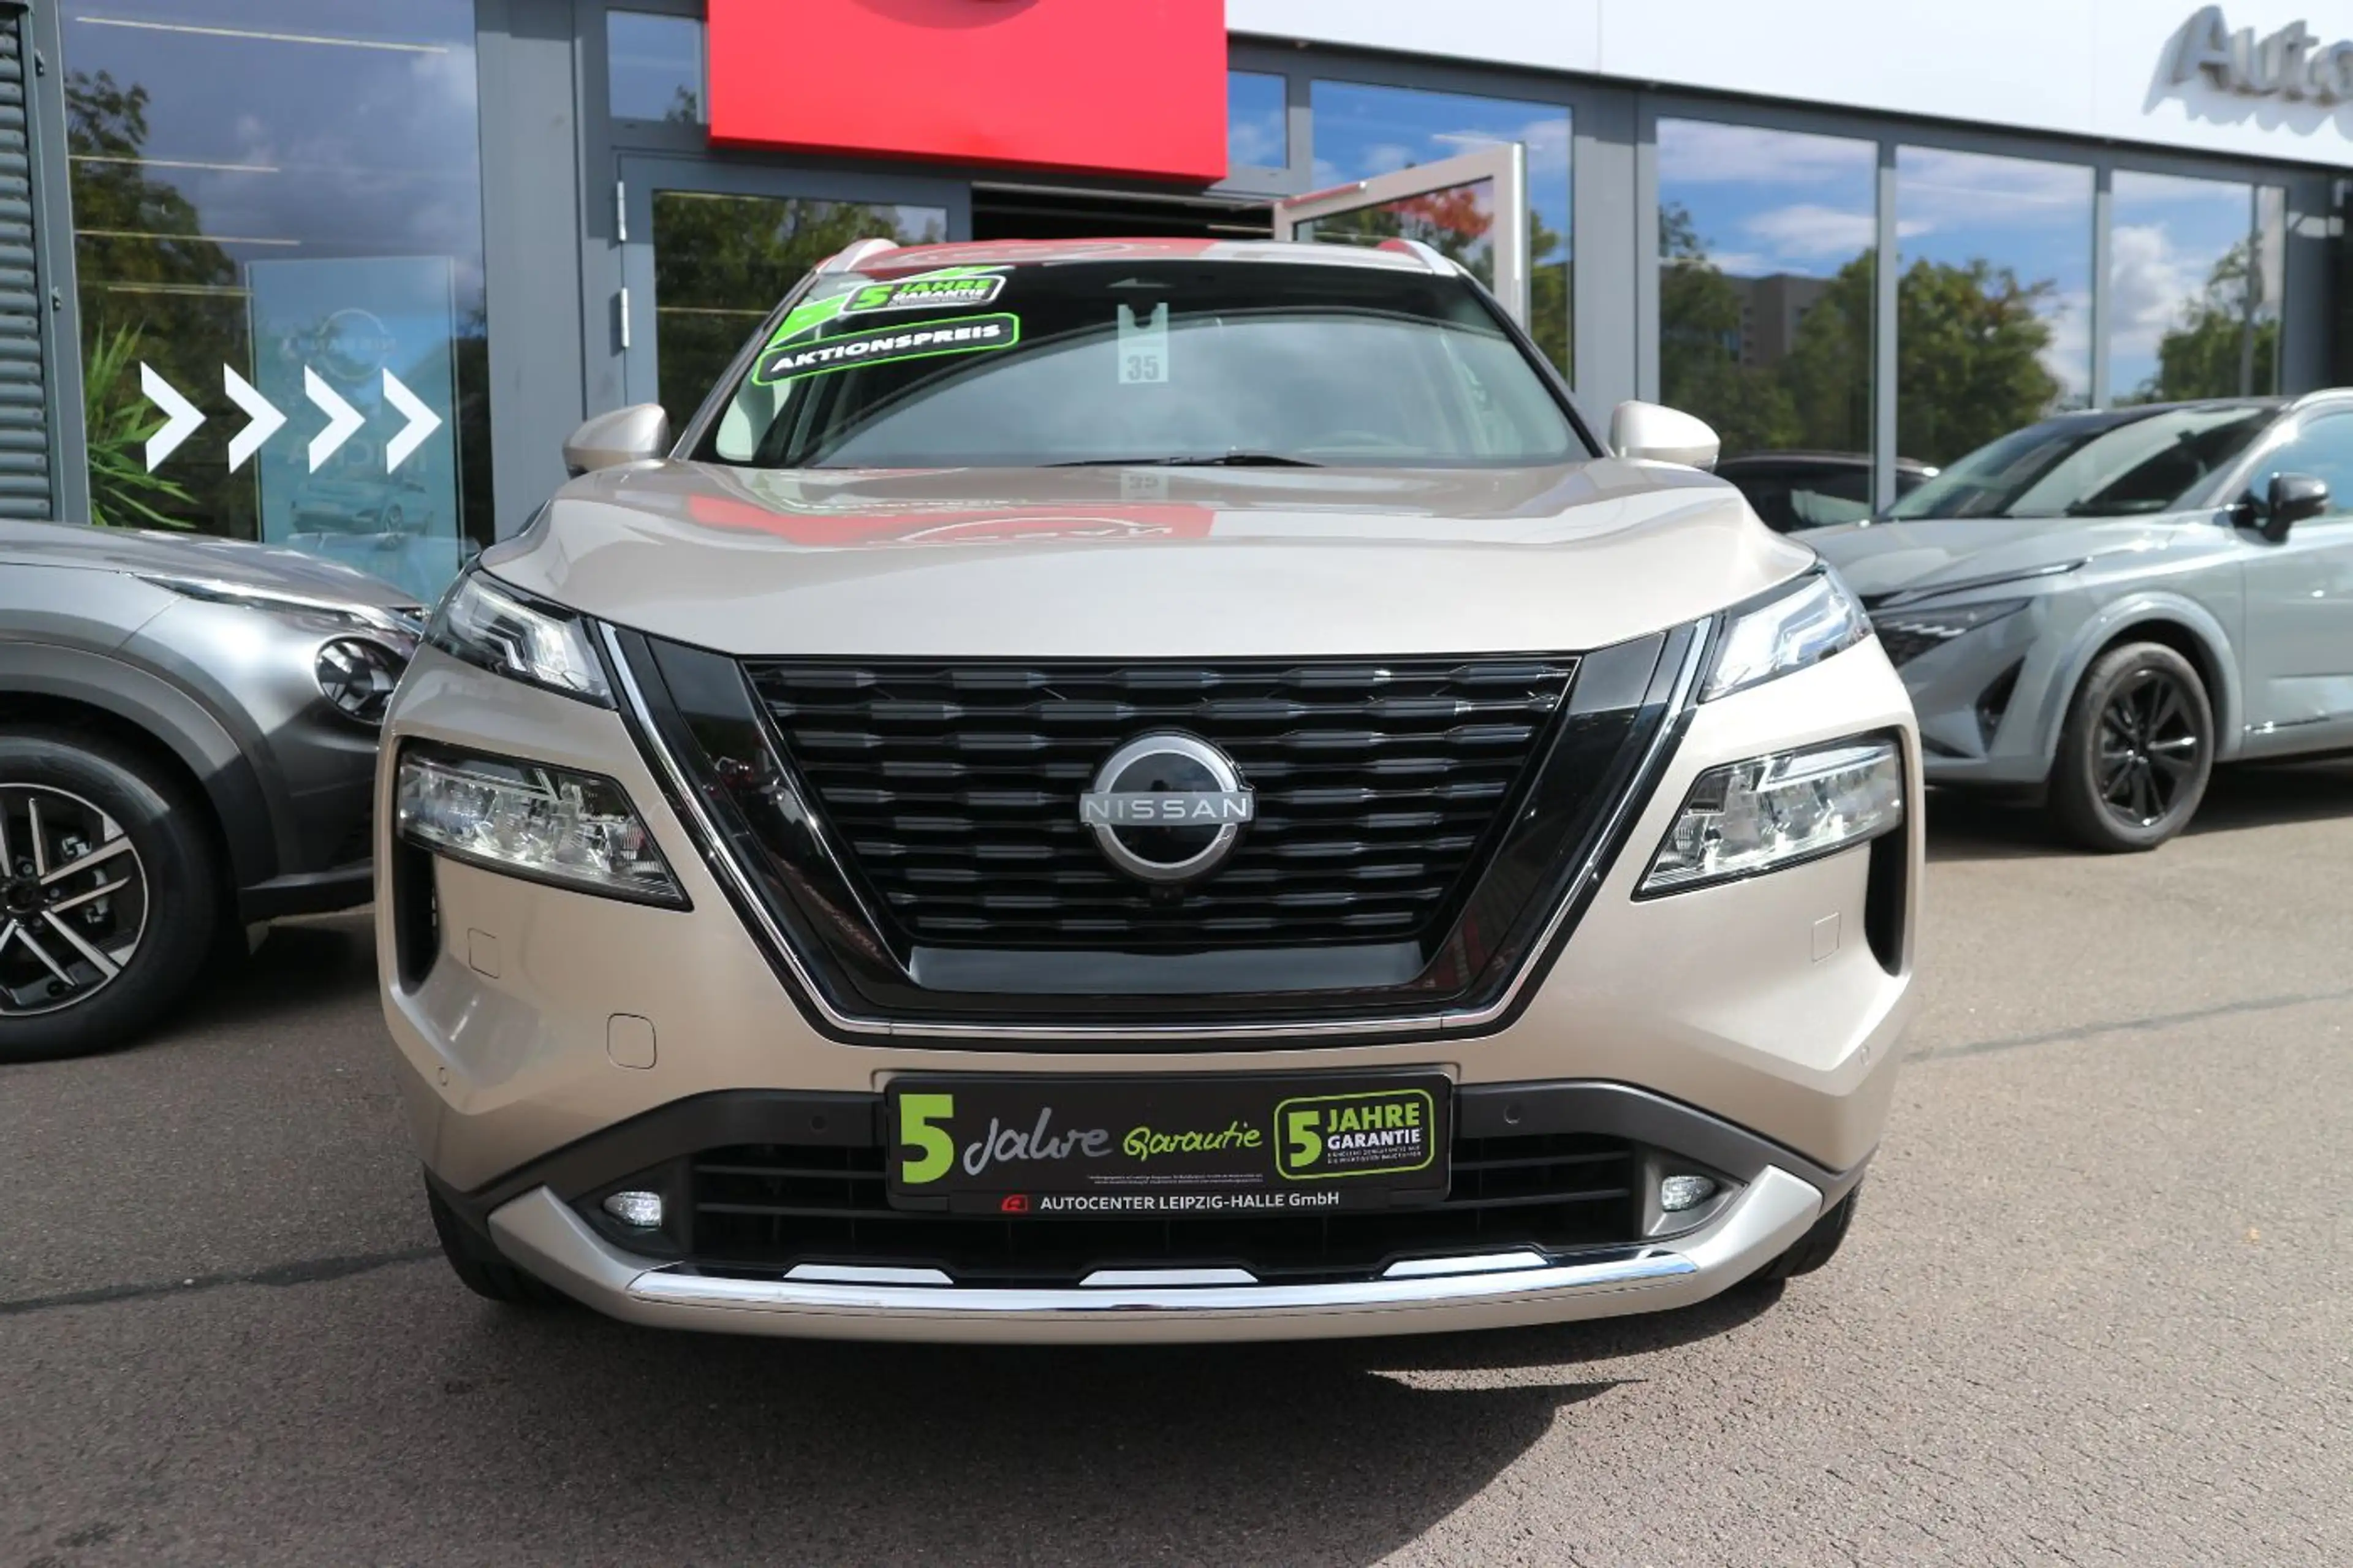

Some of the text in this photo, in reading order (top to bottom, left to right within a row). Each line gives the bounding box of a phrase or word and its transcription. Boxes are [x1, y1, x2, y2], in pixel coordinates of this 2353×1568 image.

[851, 285, 893, 309] 5
[901, 279, 993, 293] JAHRE
[770, 324, 1001, 372] AKTIONSPREIS
[1127, 355, 1160, 381] 35
[1085, 798, 1247, 819] NISSAN
[1327, 1102, 1420, 1133] JAHRE
[899, 1094, 1263, 1184] 5 Jahre Garantie
[1288, 1110, 1322, 1167] 5
[1327, 1129, 1422, 1150] GARANTIE
[1040, 1192, 1340, 1211] AUTOCENTER LEIPZIG-HALLE GmbH
